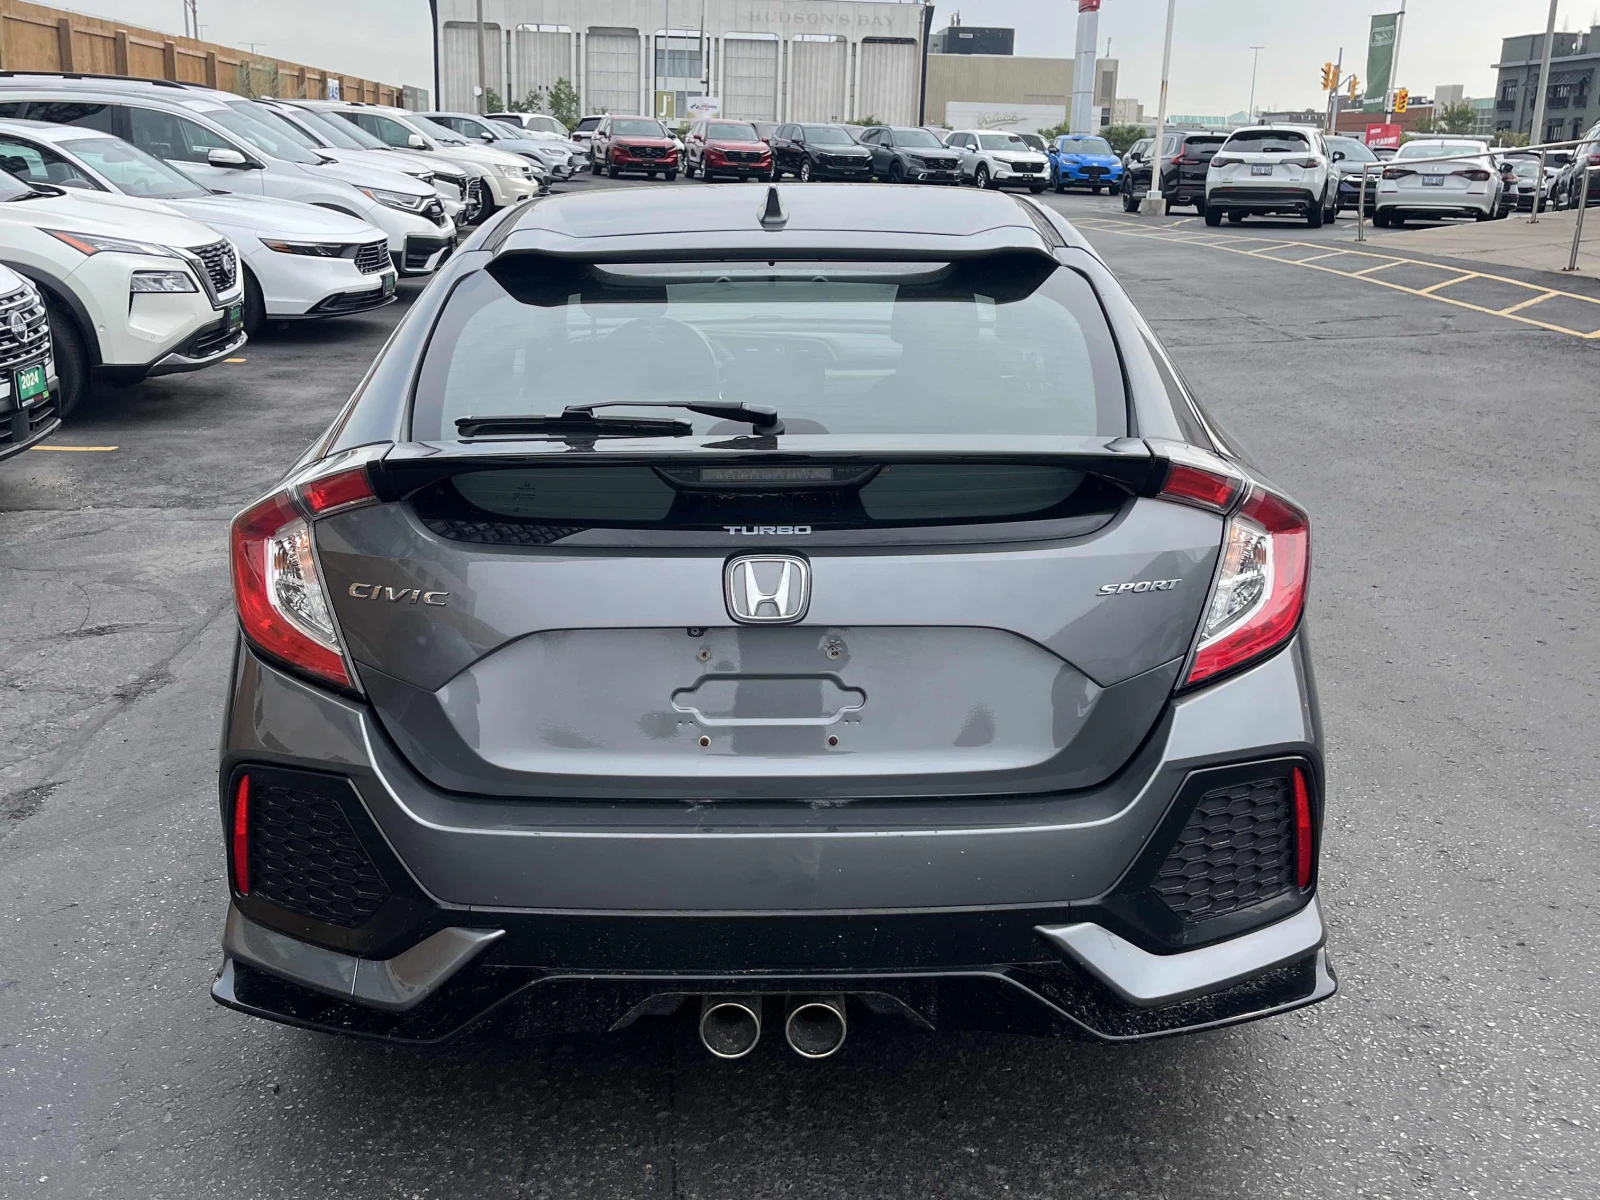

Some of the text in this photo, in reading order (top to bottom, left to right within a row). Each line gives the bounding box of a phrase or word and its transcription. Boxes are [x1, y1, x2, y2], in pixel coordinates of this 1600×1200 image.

[749, 10, 896, 27] HUDSON'S BAY
[21, 370, 40, 390] 2024
[723, 525, 812, 535] TURBO
[348, 582, 450, 606] CIVIC
[1097, 578, 1183, 596] SPORT
